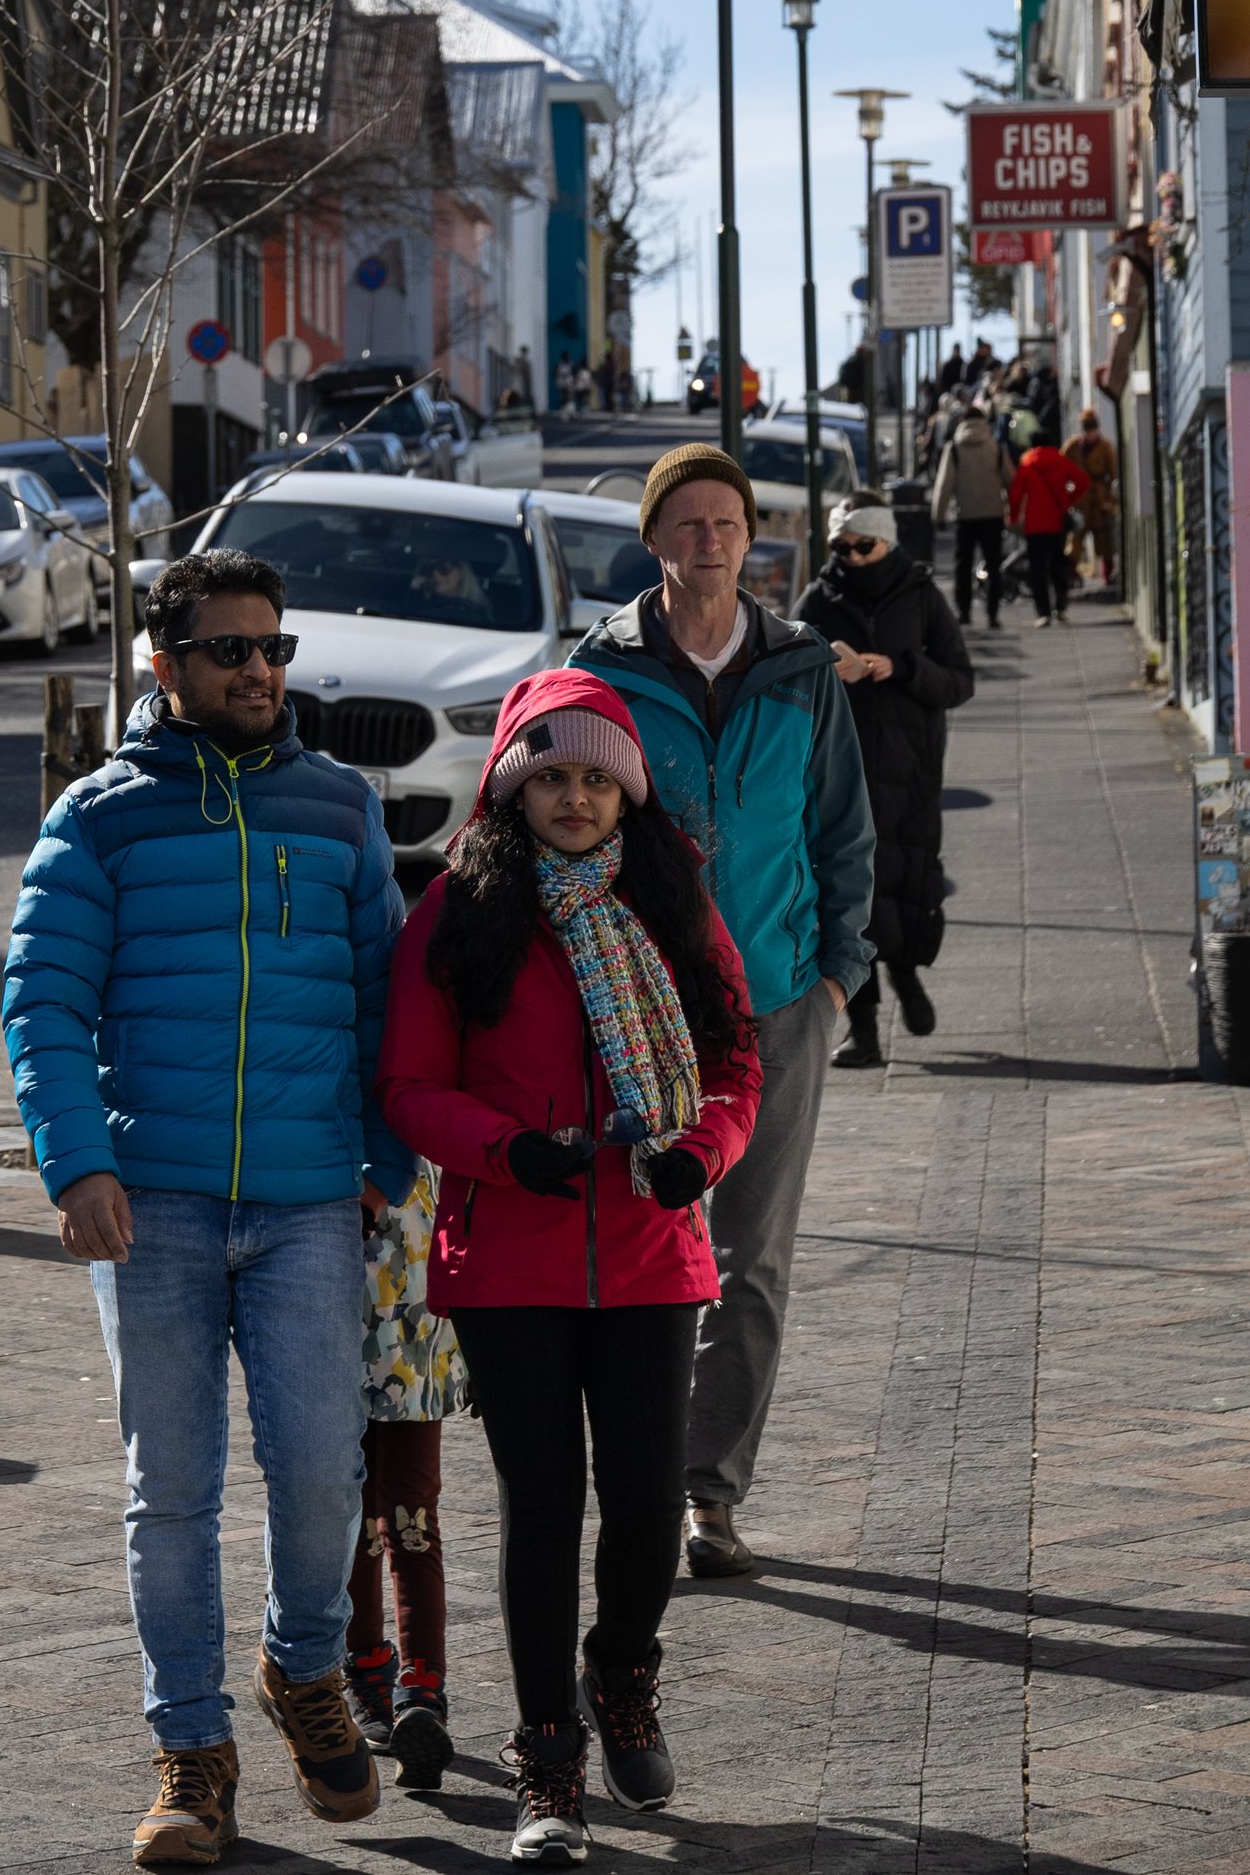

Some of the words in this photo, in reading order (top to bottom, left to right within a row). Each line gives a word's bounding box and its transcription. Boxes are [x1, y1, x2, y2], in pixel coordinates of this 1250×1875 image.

[995, 155, 1090, 191] CHIPS
[1069, 197, 1106, 217] FISH
[898, 206, 929, 250] P
[773, 684, 810, 702] Marmot
